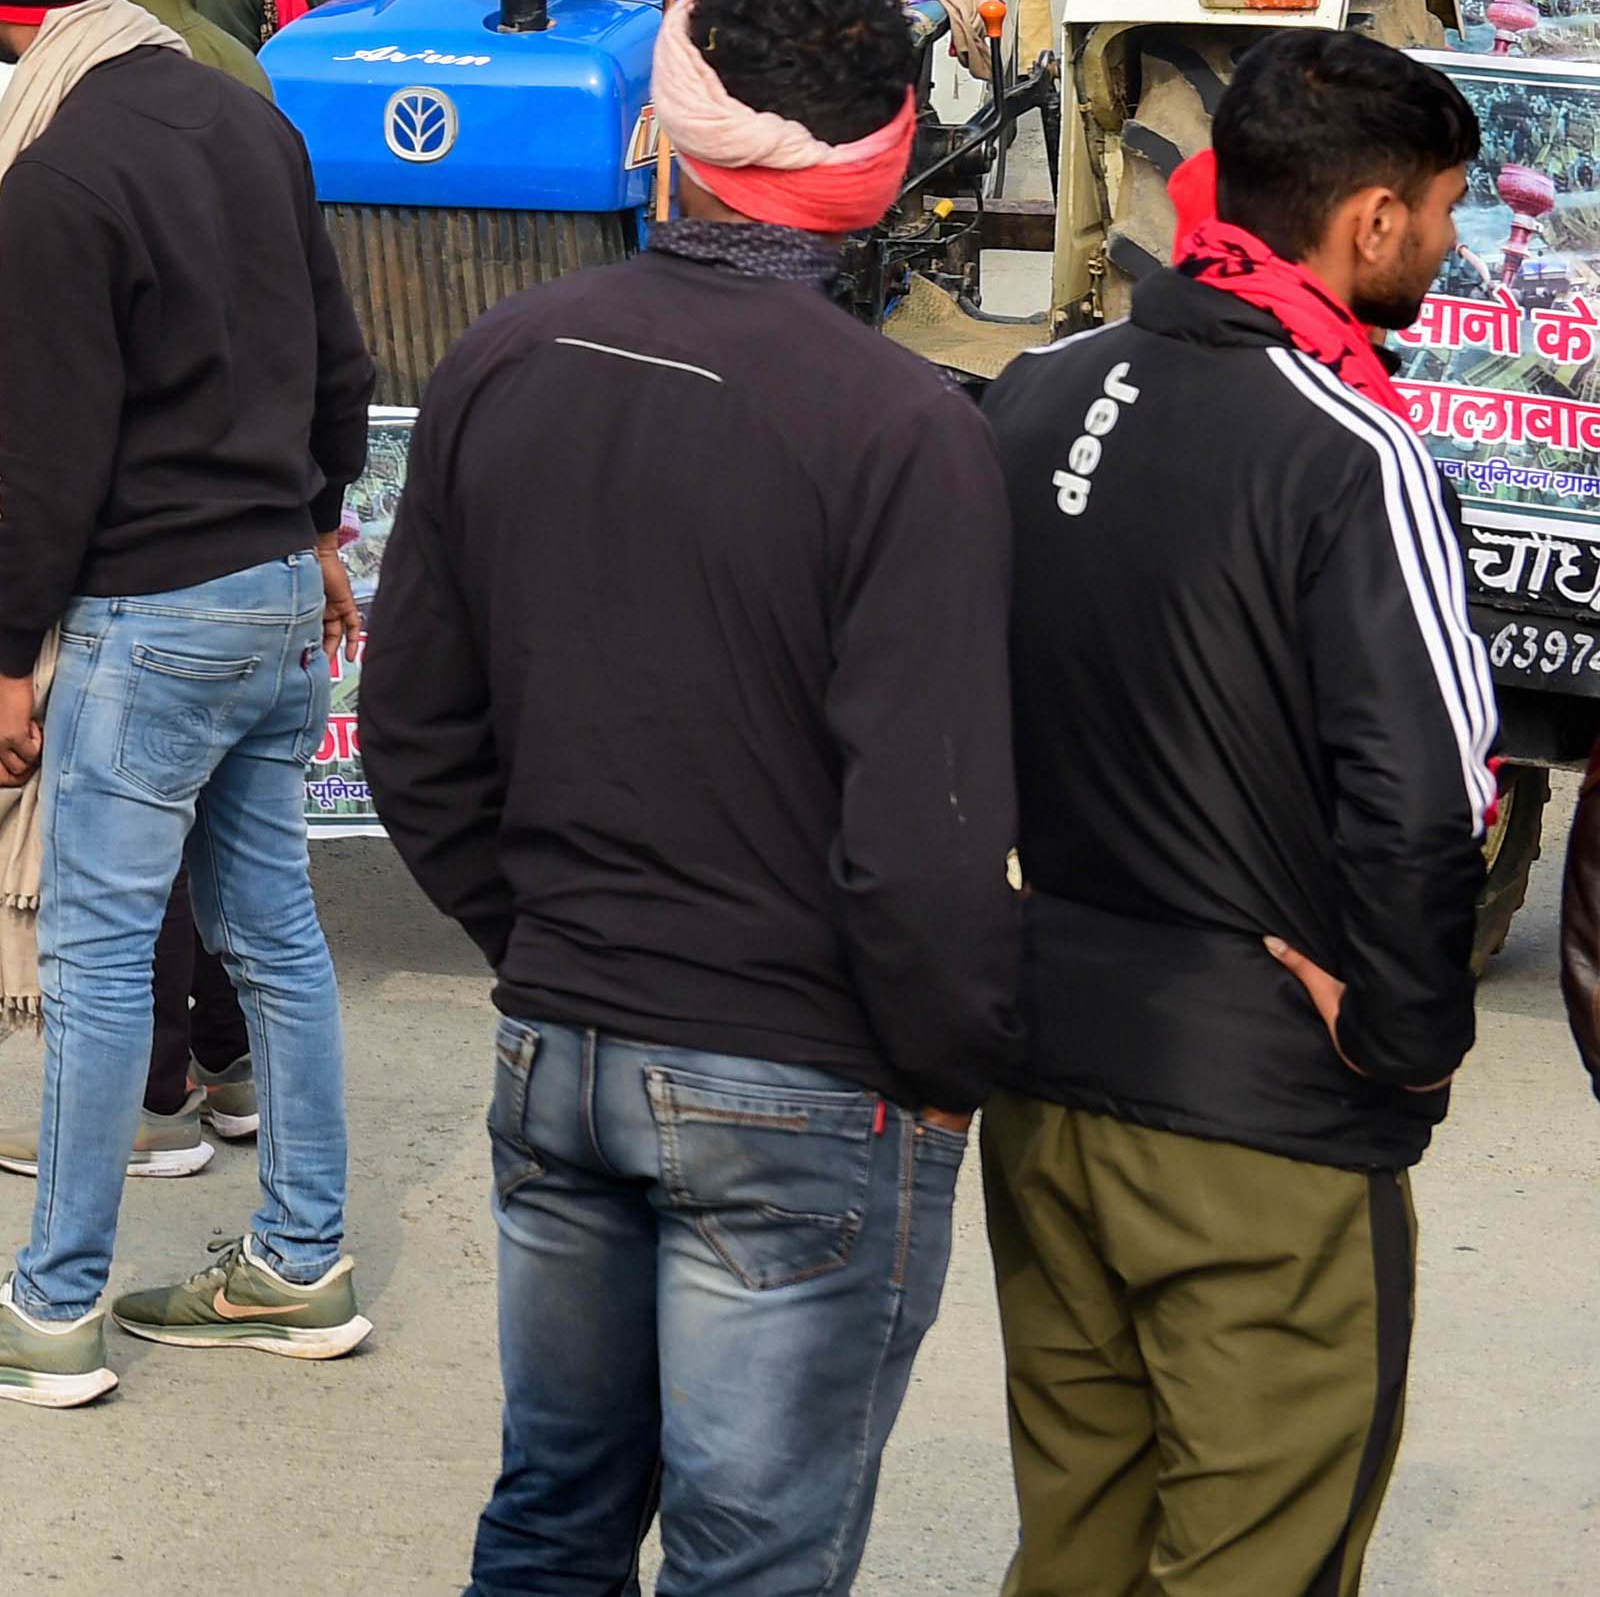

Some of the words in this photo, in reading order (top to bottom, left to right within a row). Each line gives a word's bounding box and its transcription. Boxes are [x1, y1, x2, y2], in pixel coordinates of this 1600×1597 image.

[333, 45, 492, 67] Arjun
[1395, 287, 1522, 354] सानो
[1535, 296, 1600, 362] के
[1469, 458, 1551, 492] यूनियन
